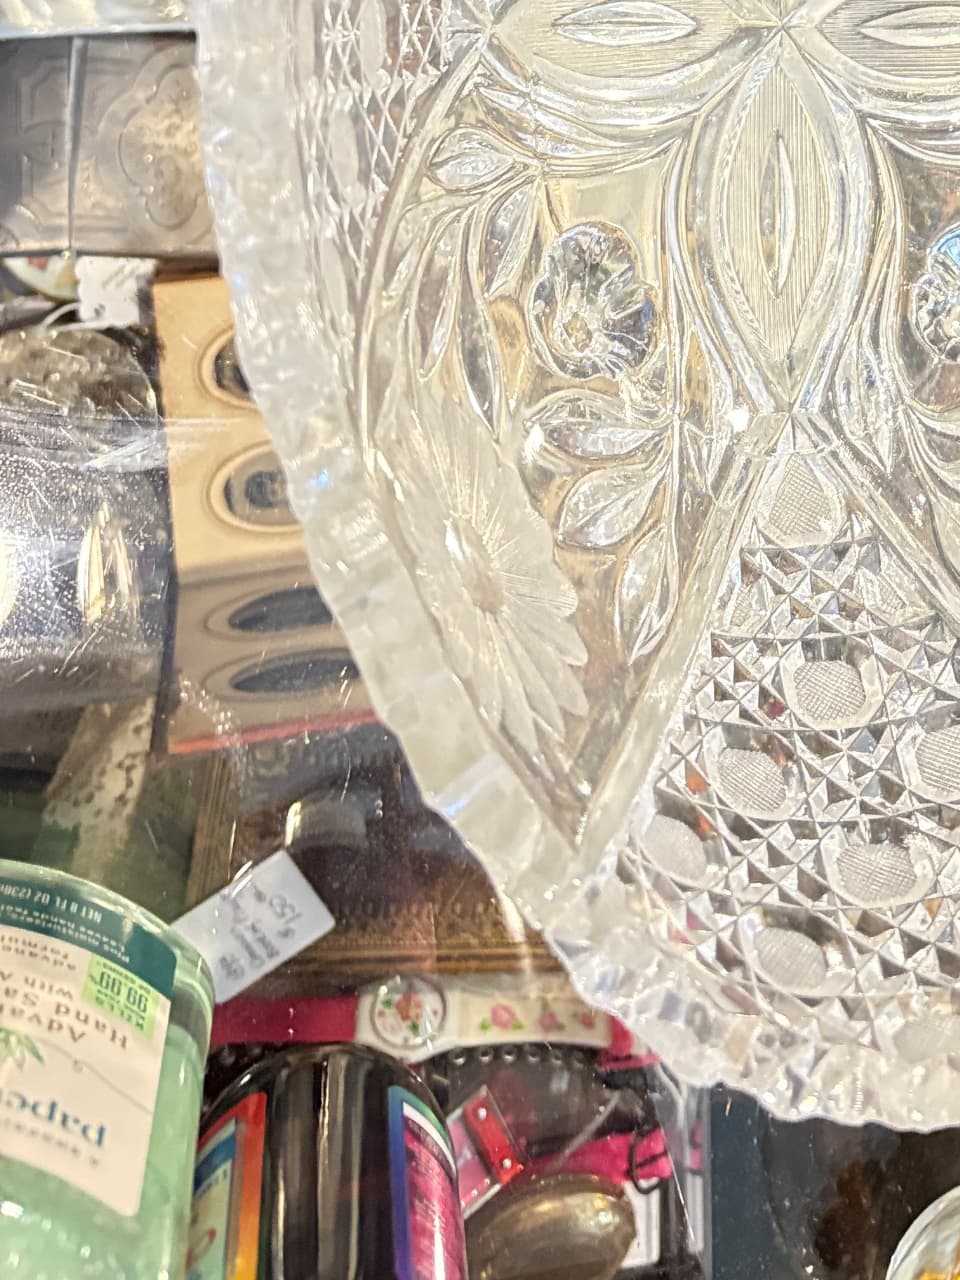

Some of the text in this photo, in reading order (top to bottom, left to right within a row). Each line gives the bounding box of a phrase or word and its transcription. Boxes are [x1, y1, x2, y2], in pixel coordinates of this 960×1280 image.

[34, 891, 50, 905] OZ
[56, 896, 67, 911] FL
[81, 906, 102, 923] NET
[104, 944, 129, 963] Plus
[25, 976, 73, 1000] with
[88, 972, 148, 1014] 99.99%
[55, 1003, 127, 1050] Hand
